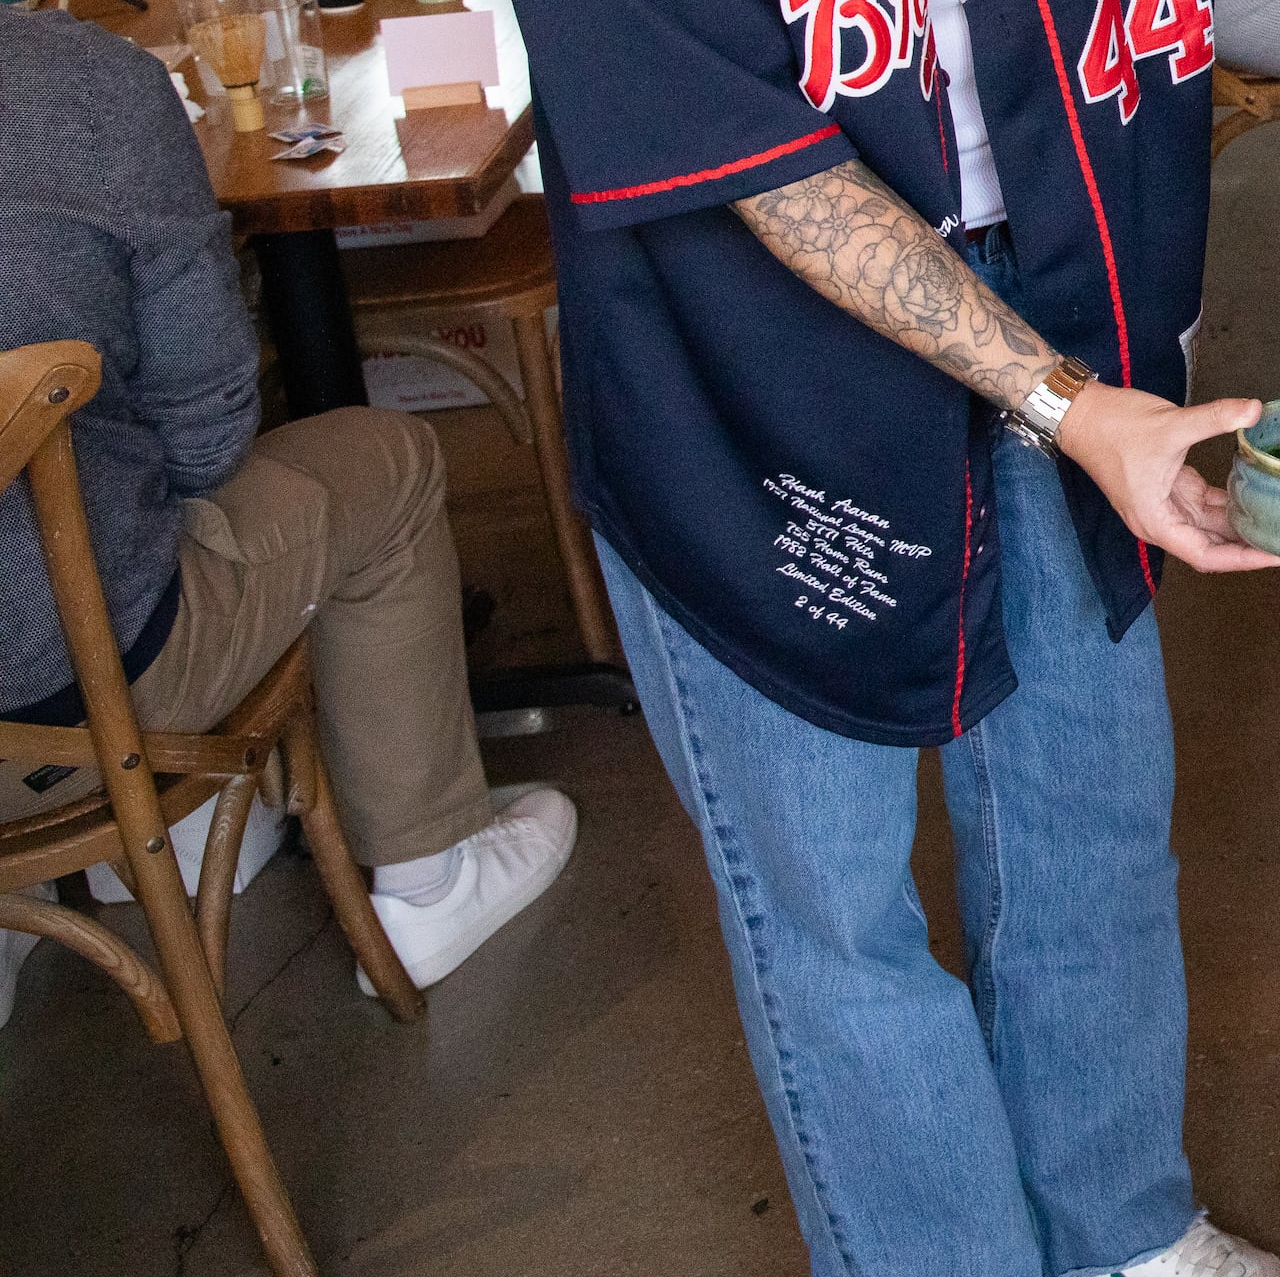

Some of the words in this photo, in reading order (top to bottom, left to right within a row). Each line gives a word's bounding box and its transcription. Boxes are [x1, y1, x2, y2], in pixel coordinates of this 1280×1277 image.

[779, 473, 826, 503] Hank
[831, 498, 890, 529] Aaron
[790, 496, 844, 527] National
[841, 523, 886, 547] League
[889, 539, 932, 560] MVP
[773, 534, 807, 558] 1982
[809, 552, 843, 578] Hall
[842, 574, 860, 589] of
[859, 580, 898, 607] Fame
[786, 521, 812, 542] 755
[813, 537, 850, 564] Home
[852, 557, 889, 584] Runs
[845, 536, 875, 559] Hits
[775, 562, 830, 594] Limited
[828, 587, 877, 621] Edition
[794, 595, 809, 608] 2
[808, 605, 826, 620] of
